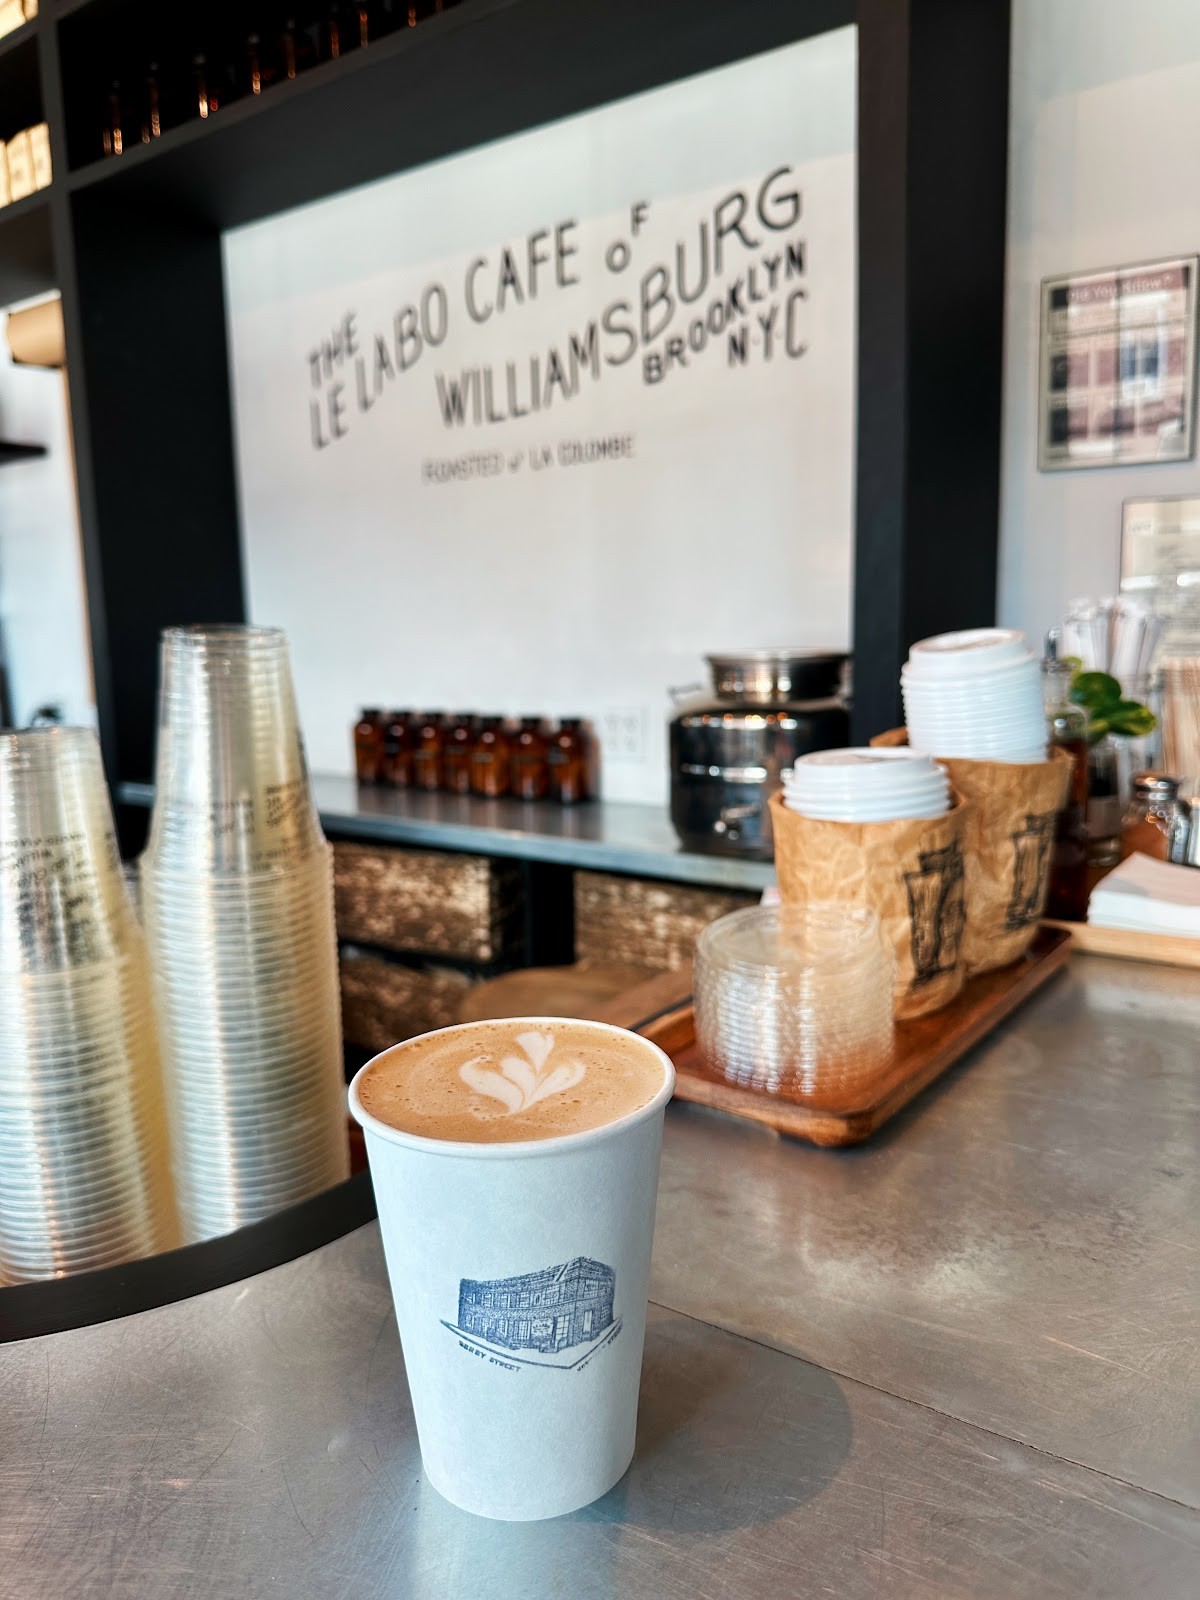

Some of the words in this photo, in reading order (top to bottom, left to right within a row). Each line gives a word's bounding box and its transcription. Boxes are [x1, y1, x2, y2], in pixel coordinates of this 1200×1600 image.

[307, 311, 360, 388] THE
[308, 383, 349, 450] LE
[354, 283, 449, 412] LABO
[464, 220, 580, 324] CAFE
[435, 165, 803, 429] WILLIAMSBURG
[642, 240, 807, 387] BROOKLYN
[727, 289, 809, 368] NYC
